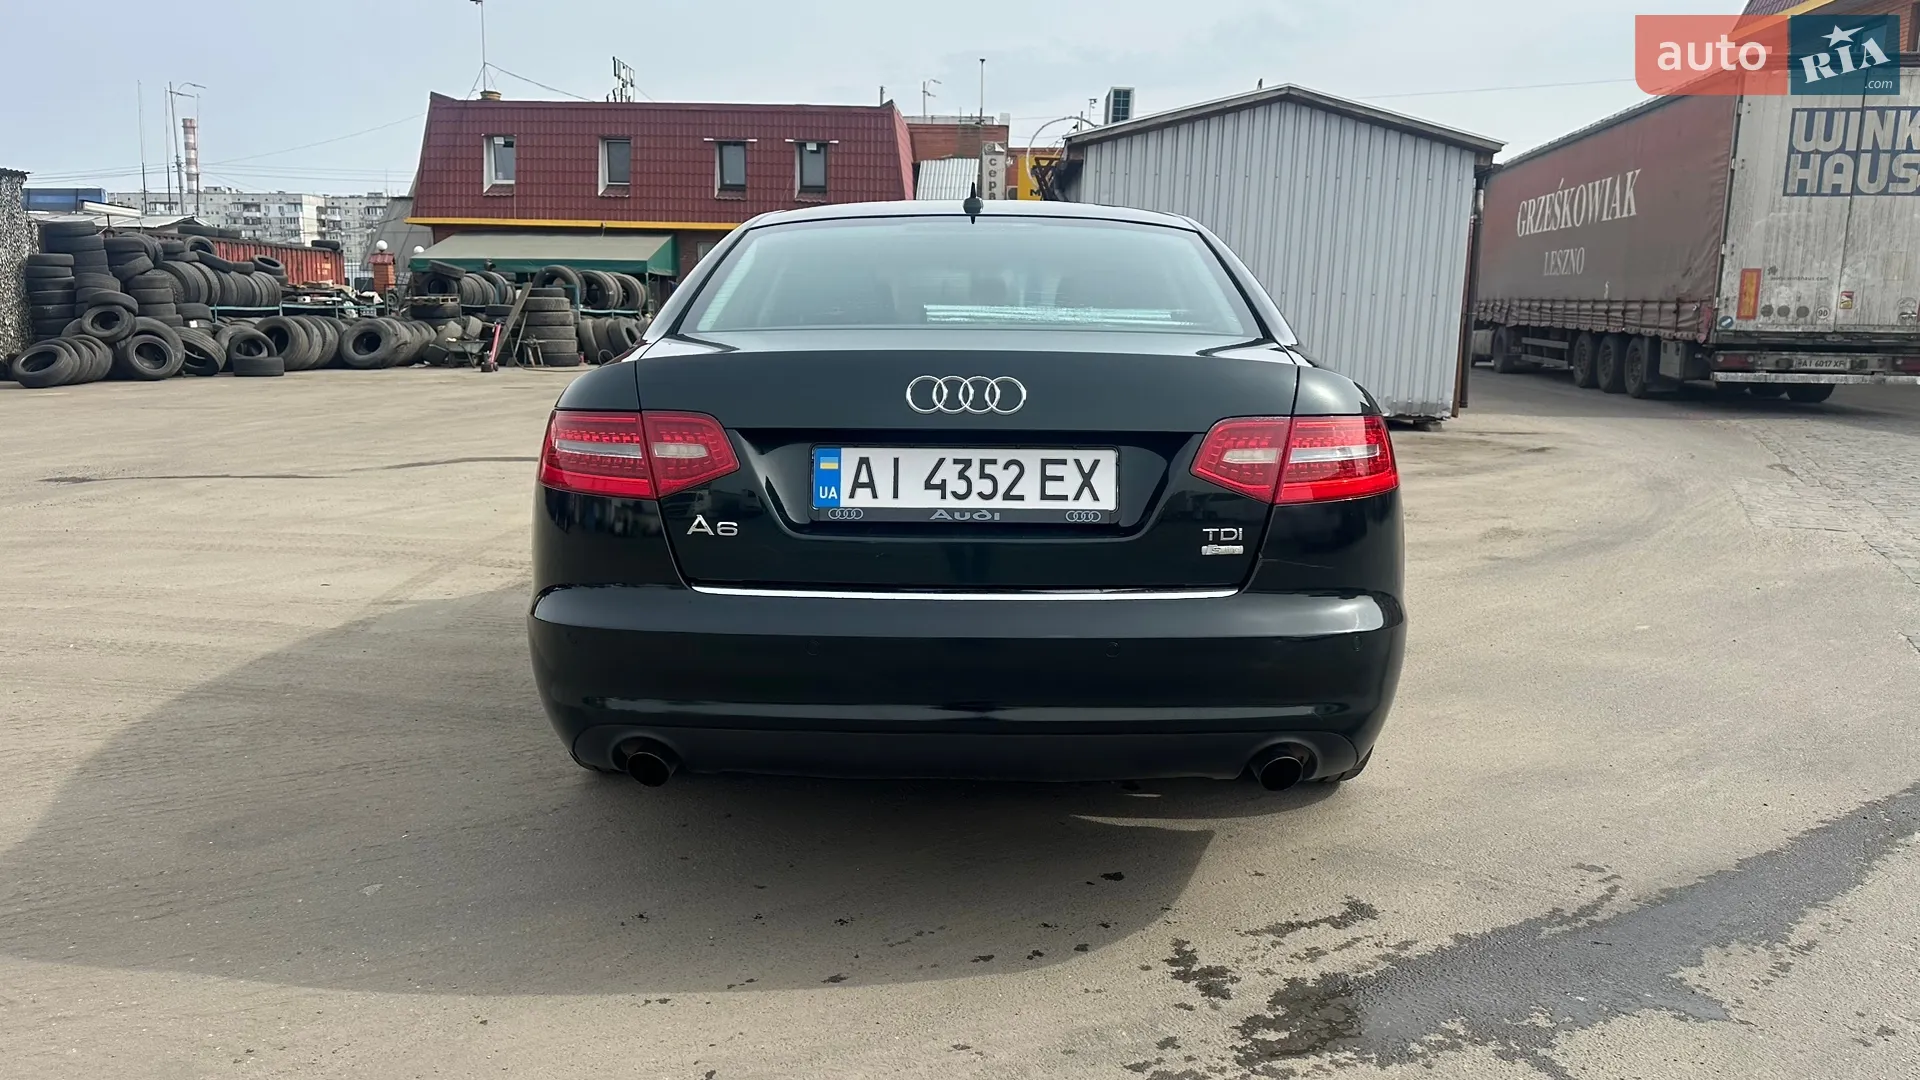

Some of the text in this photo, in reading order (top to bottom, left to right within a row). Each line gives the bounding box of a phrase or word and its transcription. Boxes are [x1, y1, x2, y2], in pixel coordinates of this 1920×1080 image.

[1791, 109, 1920, 152] WINK
[1786, 152, 1919, 195] HAUS
[1516, 168, 1642, 237] GRZEŚKOWIAK
[1543, 247, 1586, 276] LESZNO
[819, 486, 838, 499] UA
[848, 456, 1101, 502] AI 4352 EX
[686, 514, 738, 537] A6
[1202, 527, 1243, 541] TDI
